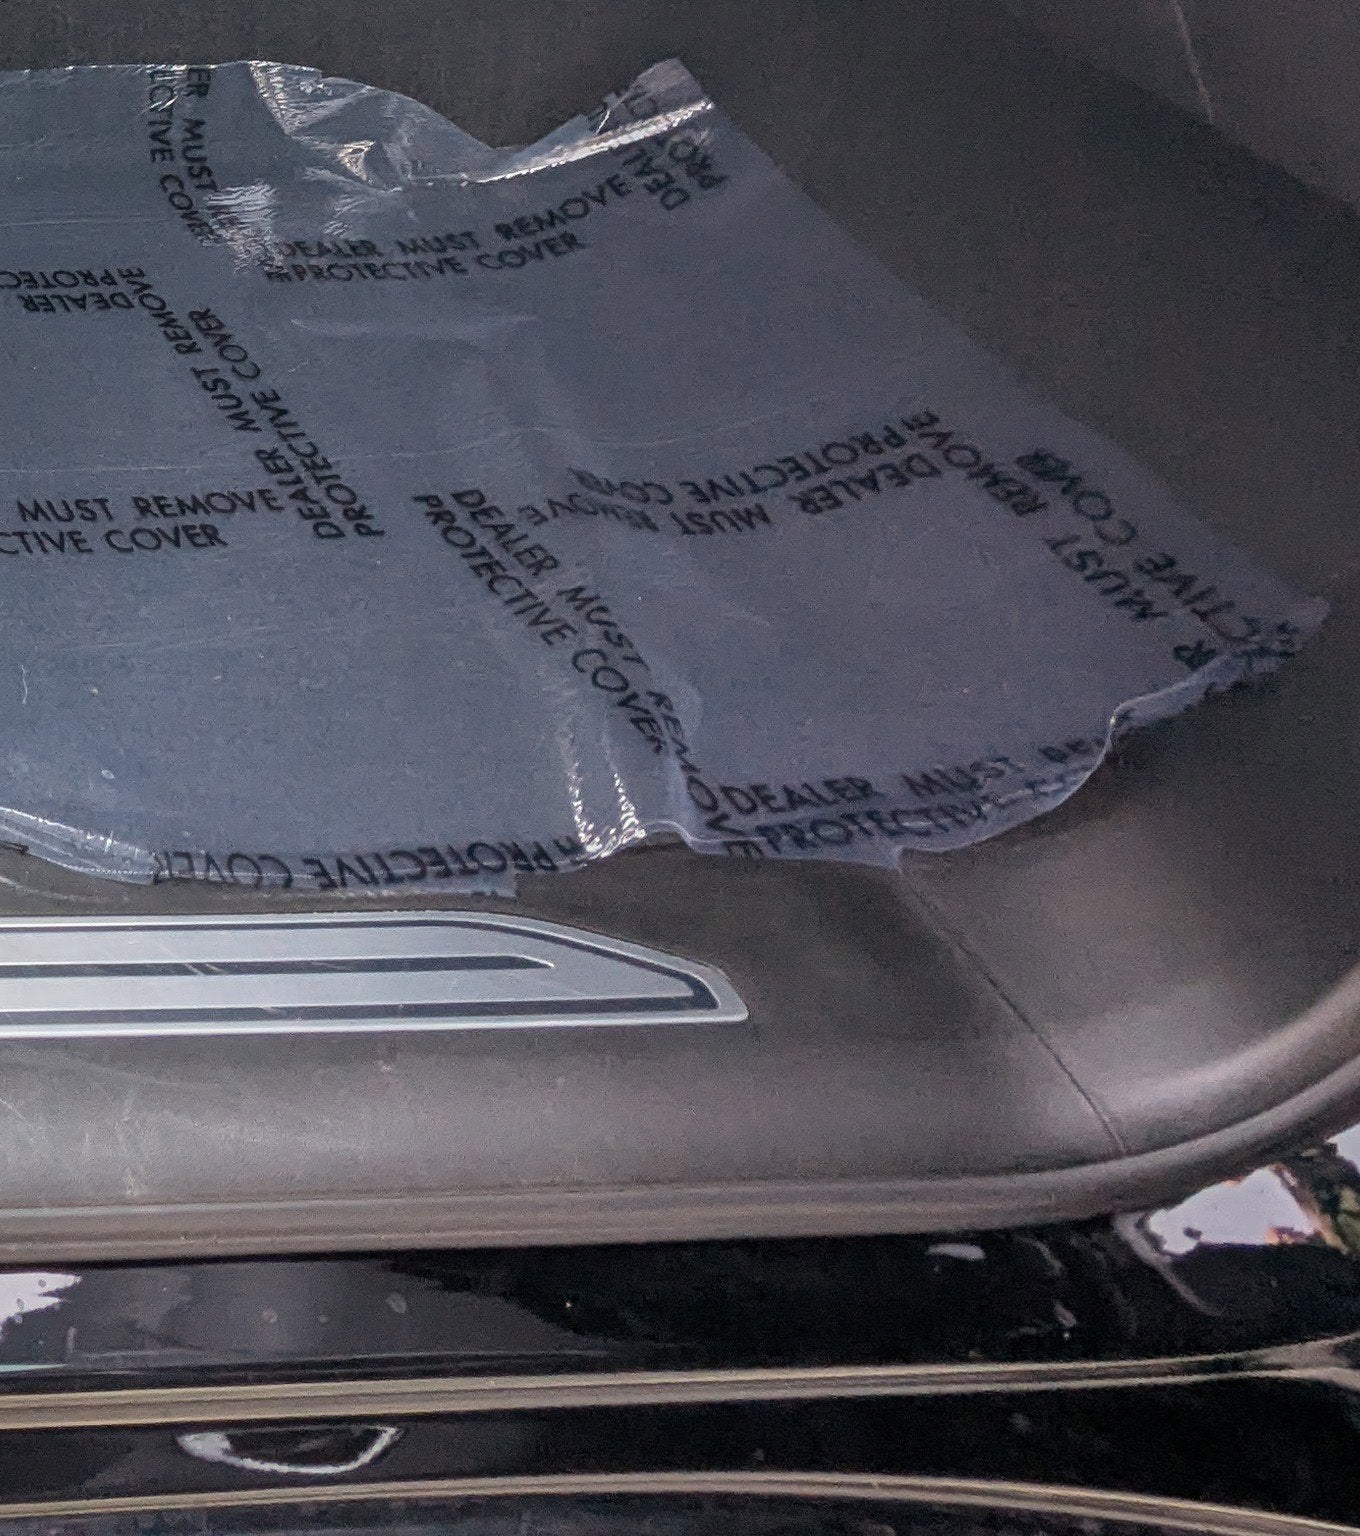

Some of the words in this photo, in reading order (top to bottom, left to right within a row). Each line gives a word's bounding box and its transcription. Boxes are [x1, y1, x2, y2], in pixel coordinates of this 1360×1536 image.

[182, 117, 219, 192] MUST
[280, 237, 383, 260] DEALER
[396, 230, 481, 256] MUST
[494, 172, 634, 243] REMOVE
[293, 257, 469, 283] PROTECTIVE
[476, 230, 586, 270] COVER
[16, 290, 136, 314] DEALER
[117, 267, 203, 356] REMOVE
[188, 307, 262, 380] COVER
[189, 365, 263, 433] MUST
[249, 388, 386, 538] PROTECTIVE
[254, 446, 347, 540] DEALER
[679, 424, 909, 505] PROTECTIVE
[789, 451, 943, 516] DEALER
[16, 496, 115, 524] MUST
[131, 487, 285, 520] REMOVE
[103, 522, 229, 554] COVER
[669, 502, 774, 537] MUST
[450, 488, 561, 577] DEALER
[555, 584, 652, 672] MUST
[411, 492, 579, 647] PROTECTIVE
[572, 648, 668, 756] COVER
[718, 774, 884, 817] DEALER
[306, 840, 561, 890] PROTECTIVE
